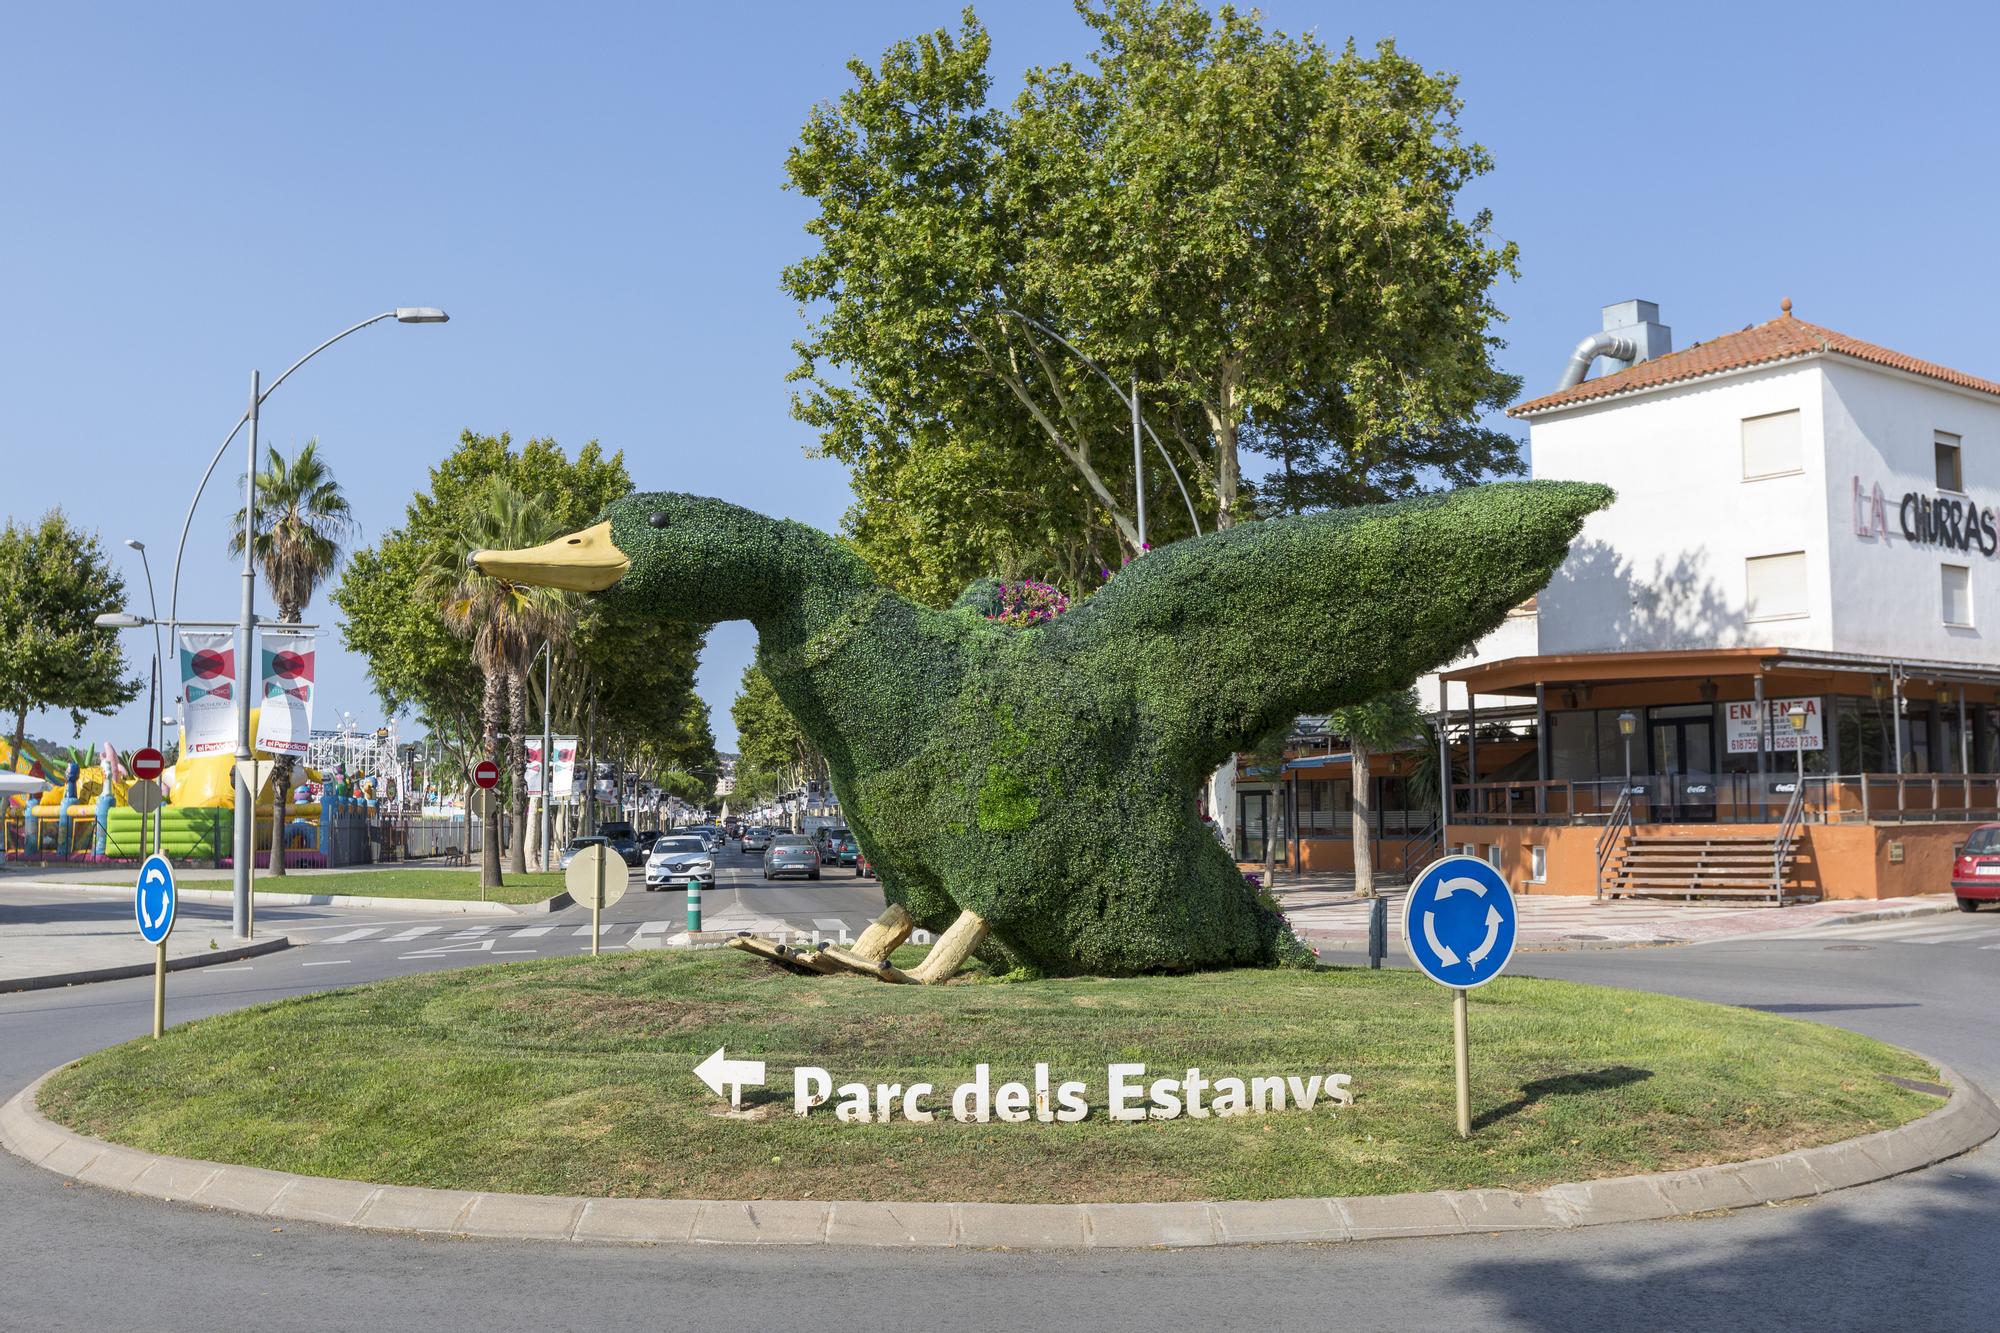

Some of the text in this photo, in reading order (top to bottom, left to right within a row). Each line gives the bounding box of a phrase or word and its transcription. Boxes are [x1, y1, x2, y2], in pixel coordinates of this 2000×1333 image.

[1853, 475, 2000, 557] LA CHURRAS
[1730, 704, 1752, 720] EN
[794, 1066, 934, 1123] Parc
[952, 1063, 1089, 1123] dels
